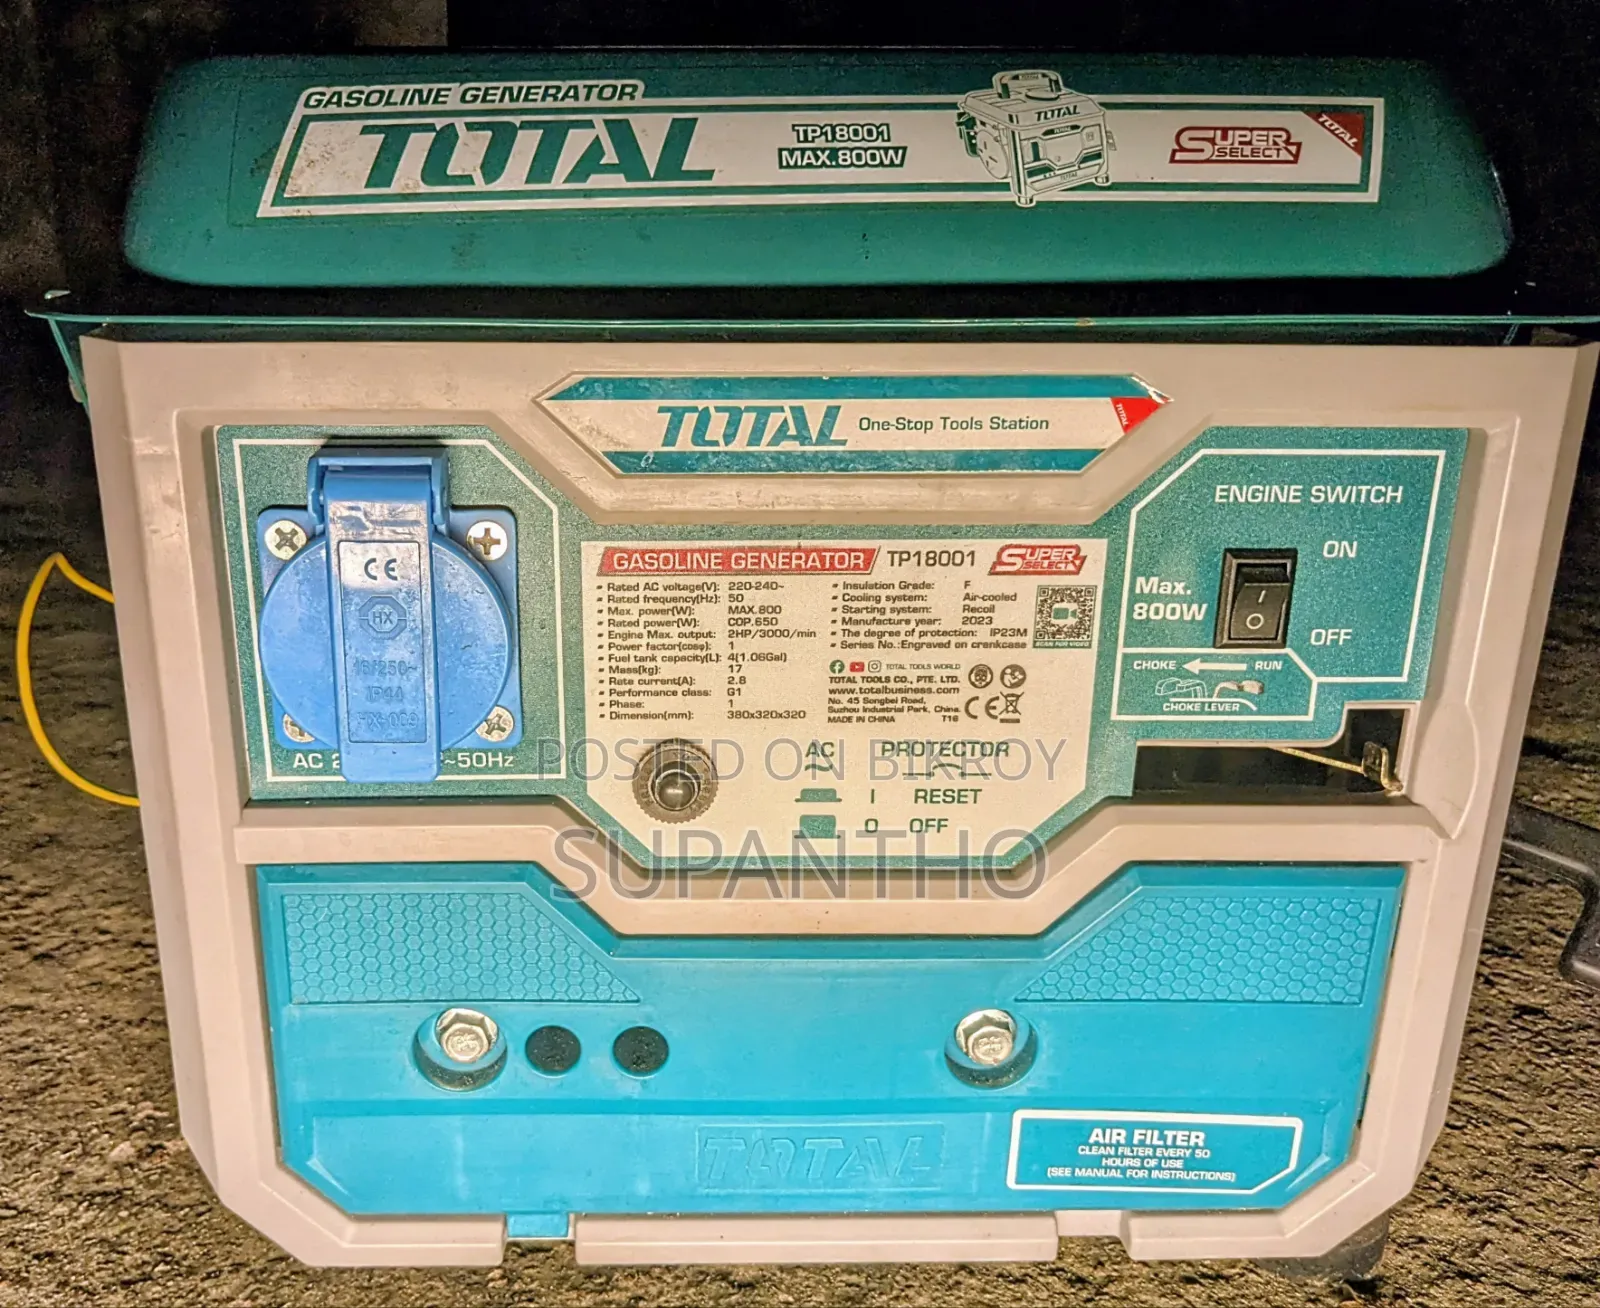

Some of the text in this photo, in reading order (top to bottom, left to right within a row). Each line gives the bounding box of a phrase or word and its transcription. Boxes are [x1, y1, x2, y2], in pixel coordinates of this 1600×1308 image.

[303, 83, 637, 109] GASOLINE GENERATOR
[1035, 105, 1080, 121] TOTAL
[792, 124, 891, 143] TP18001
[1318, 113, 1359, 147] TOTAL
[1174, 129, 1288, 160] SUPER
[359, 117, 717, 189] TOTAL
[780, 148, 904, 167] MAX.800W
[1215, 148, 1283, 158] SELECT
[657, 405, 849, 447] TOTAL
[858, 415, 1050, 433] One-Stop Tools Station
[1214, 485, 1403, 504] ENGINE SWITCH
[1322, 541, 1357, 558] ON
[613, 550, 976, 570] GASOLINE GENERATOR TP18001
[993, 548, 1076, 570] SUPER
[1022, 561, 1070, 569] SELECT
[607, 582, 639, 592] Rated
[643, 582, 659, 591] AC
[843, 581, 934, 590] Insulation Grade:
[964, 581, 971, 590] F
[1135, 577, 1192, 595] Max.
[607, 594, 639, 603] Rated
[728, 594, 744, 603] 50
[842, 593, 927, 603] Cooling system:
[963, 592, 1017, 602] Air-cooled
[608, 606, 634, 615] Max.
[728, 605, 782, 615] MAX.800
[841, 605, 932, 615] Starting system:
[963, 604, 995, 614] Recoil
[1133, 603, 1207, 621] 800W
[372, 611, 393, 625] HX
[608, 618, 640, 627] Rated
[728, 617, 778, 626] COP.650
[841, 616, 941, 628] Manufacture year:
[962, 616, 993, 625] 2023
[608, 630, 716, 641] Engine Max. output:
[728, 629, 816, 638] 2HP/3000/min
[841, 628, 1028, 640] The degree of protection: IP23M
[1310, 629, 1352, 645] OFF
[608, 642, 642, 651] Power
[841, 640, 874, 649] Series
[971, 640, 1027, 649] crankcase
[608, 654, 630, 662] Fuel
[634, 654, 657, 663] tank
[729, 664, 742, 674] 17
[1133, 660, 1282, 670] CHOKE RUN
[609, 677, 634, 686] Rate
[727, 676, 746, 685] 2.8
[829, 676, 857, 684] TOTAL
[609, 688, 712, 698] Performance class:
[727, 688, 742, 697] G1
[829, 686, 959, 694] www.totalbusiness.com
[610, 700, 644, 709] Phase:
[1163, 703, 1240, 711] CHOKE LEVER
[610, 711, 694, 721] Dimension(mm):
[727, 710, 806, 719] 380x320x320
[805, 741, 1010, 758] AC PROTECTOR
[293, 753, 323, 768] AC
[914, 788, 982, 805] RESET
[910, 818, 949, 834] OFF
[1089, 1128, 1205, 1147] AIR FILTER
[1078, 1146, 1210, 1158] CLEAN FILTER EVERY 50
[703, 1135, 944, 1182] TOTAL
[1102, 1157, 1183, 1168] HOURS OF USE
[1048, 1167, 1236, 1182] (SEE MANUAL FOR INSTRUCTIONS)
